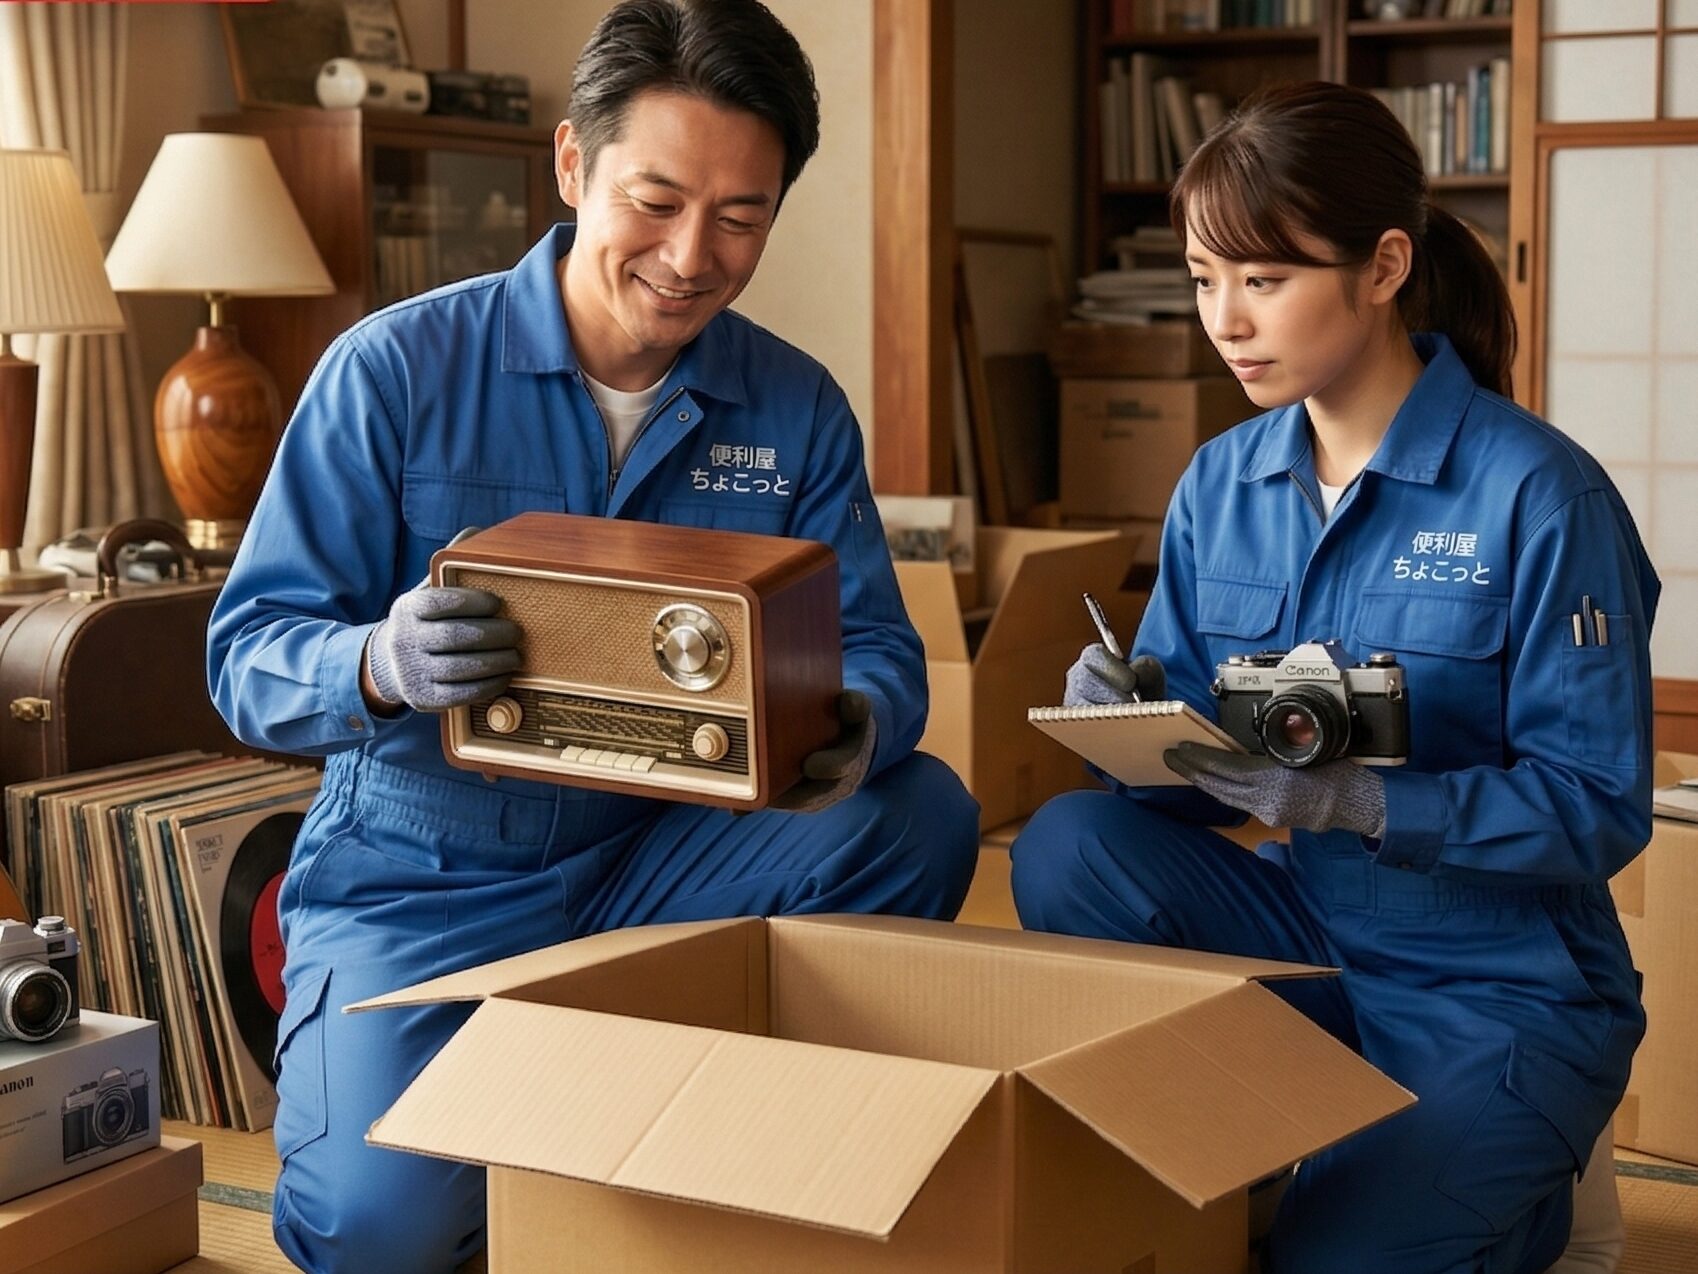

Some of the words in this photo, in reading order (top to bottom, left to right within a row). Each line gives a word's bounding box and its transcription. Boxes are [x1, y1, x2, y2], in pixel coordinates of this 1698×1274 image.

[709, 444, 777, 470] 便利屋
[690, 468, 790, 496] ちょこっと
[1412, 531, 1478, 557] 便利屋
[1393, 555, 1490, 585] ちょこっと
[1285, 665, 1330, 676] Canon
